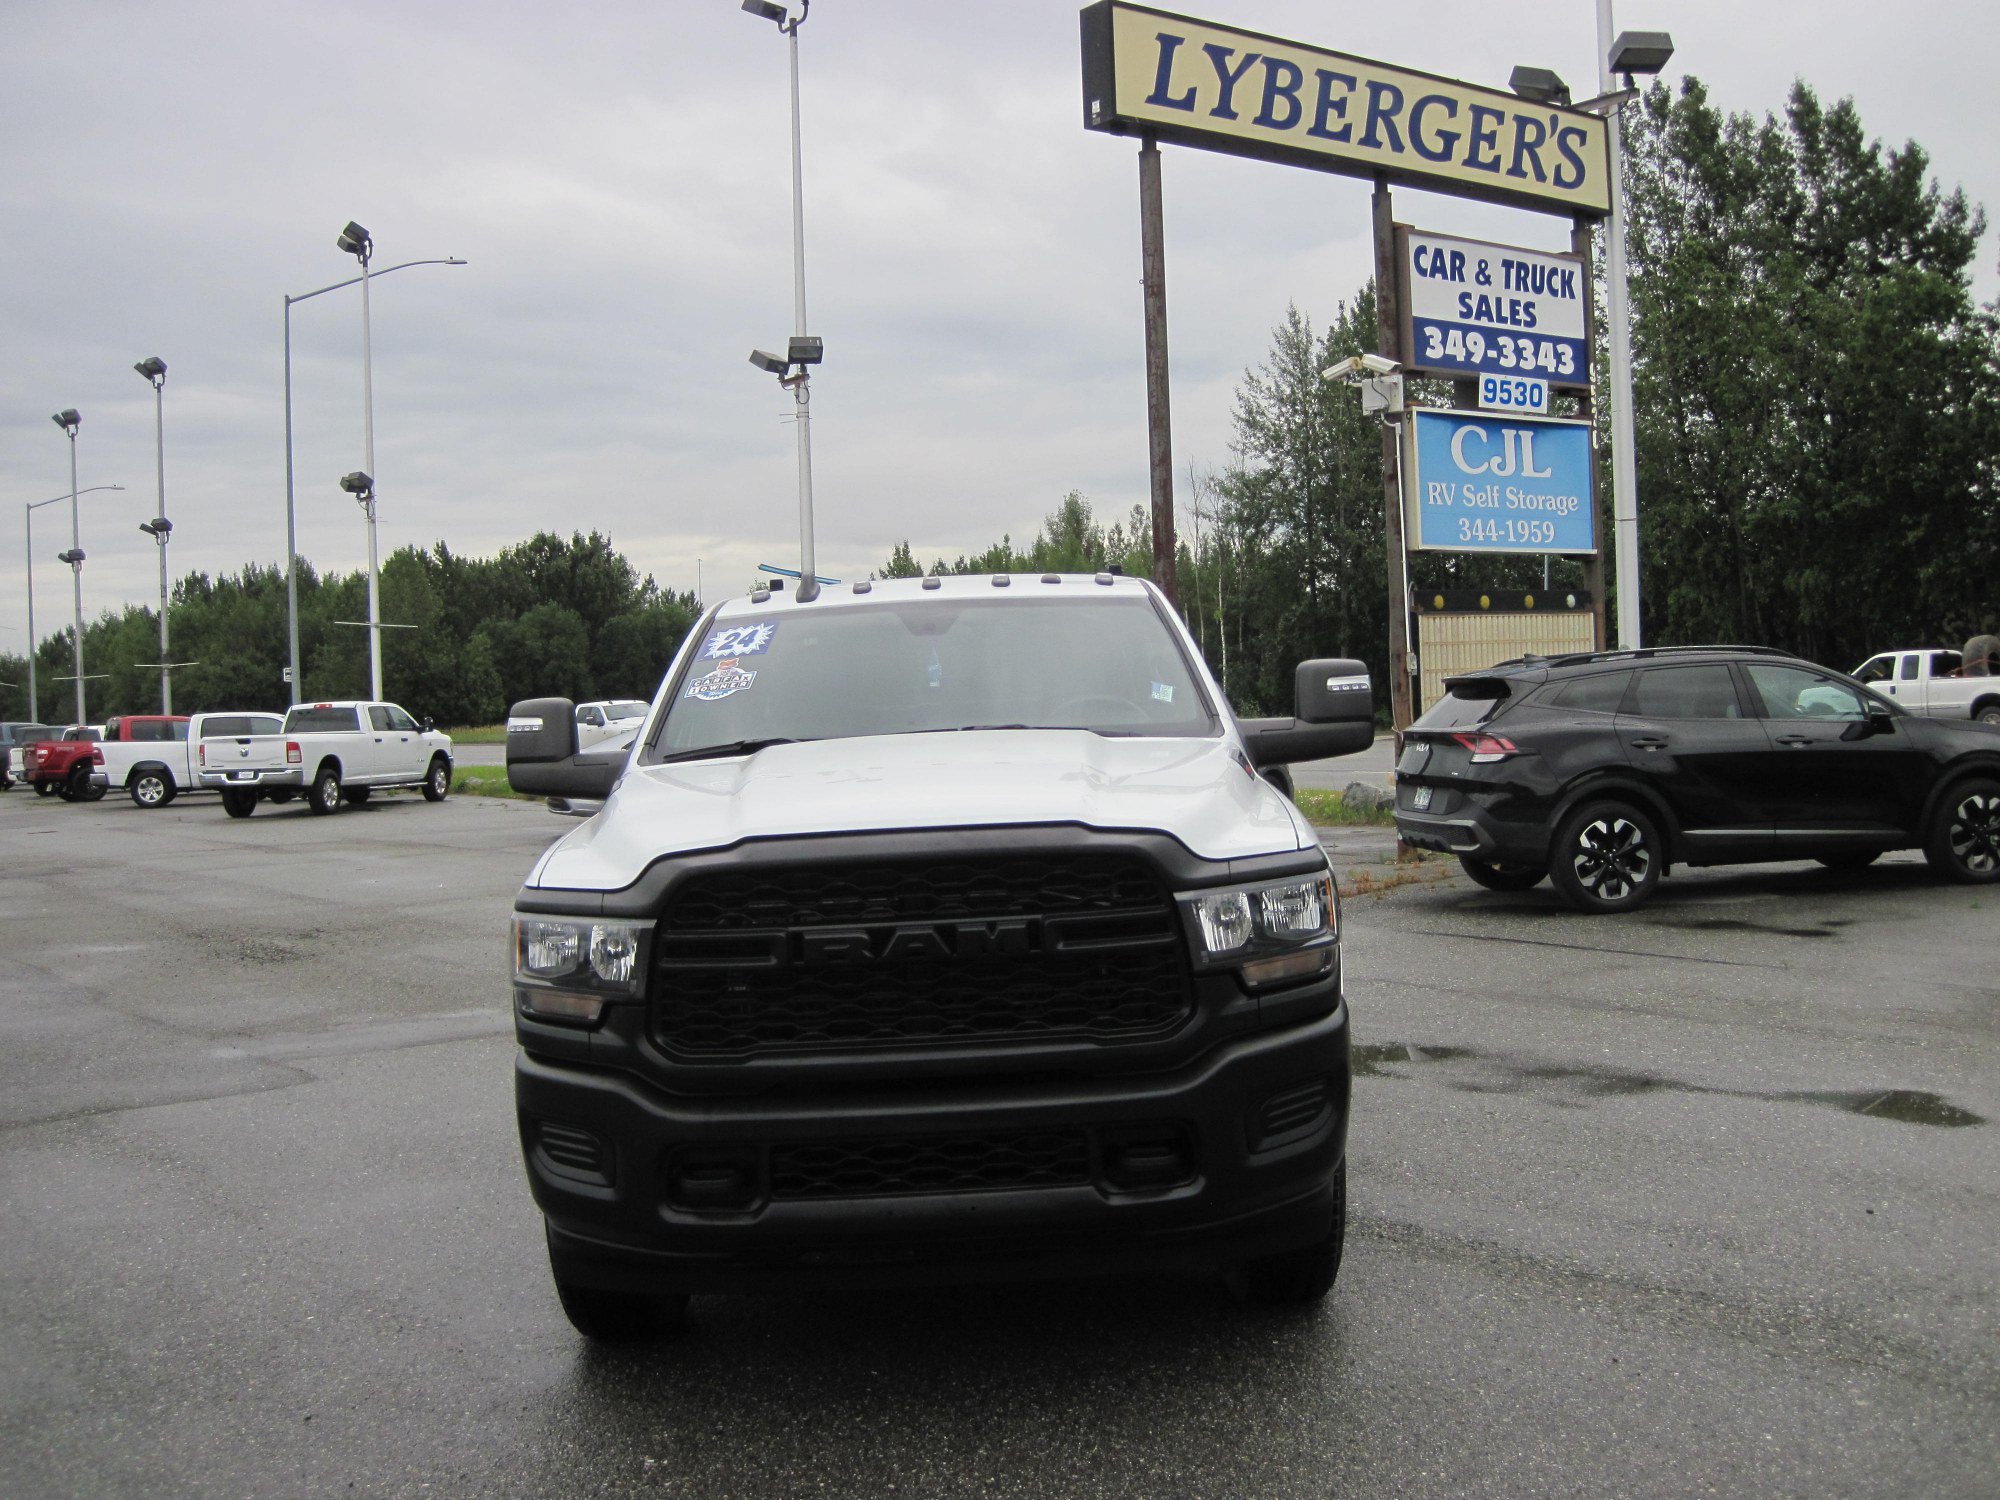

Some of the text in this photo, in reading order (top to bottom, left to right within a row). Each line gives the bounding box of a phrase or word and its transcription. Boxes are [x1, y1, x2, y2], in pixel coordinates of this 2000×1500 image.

[1144, 32, 1588, 190] LYBERGER'S
[1413, 244, 1576, 300] CAR & TRUCK
[1457, 291, 1537, 329] SALES
[1423, 326, 1575, 375] 349-3343
[1483, 377, 1543, 408] 9530
[1450, 424, 1552, 479] CJL
[1426, 481, 1579, 516] RV Self Storage
[1458, 517, 1555, 544] 344-1959
[716, 628, 760, 652] 24
[803, 924, 1028, 962] RAM
